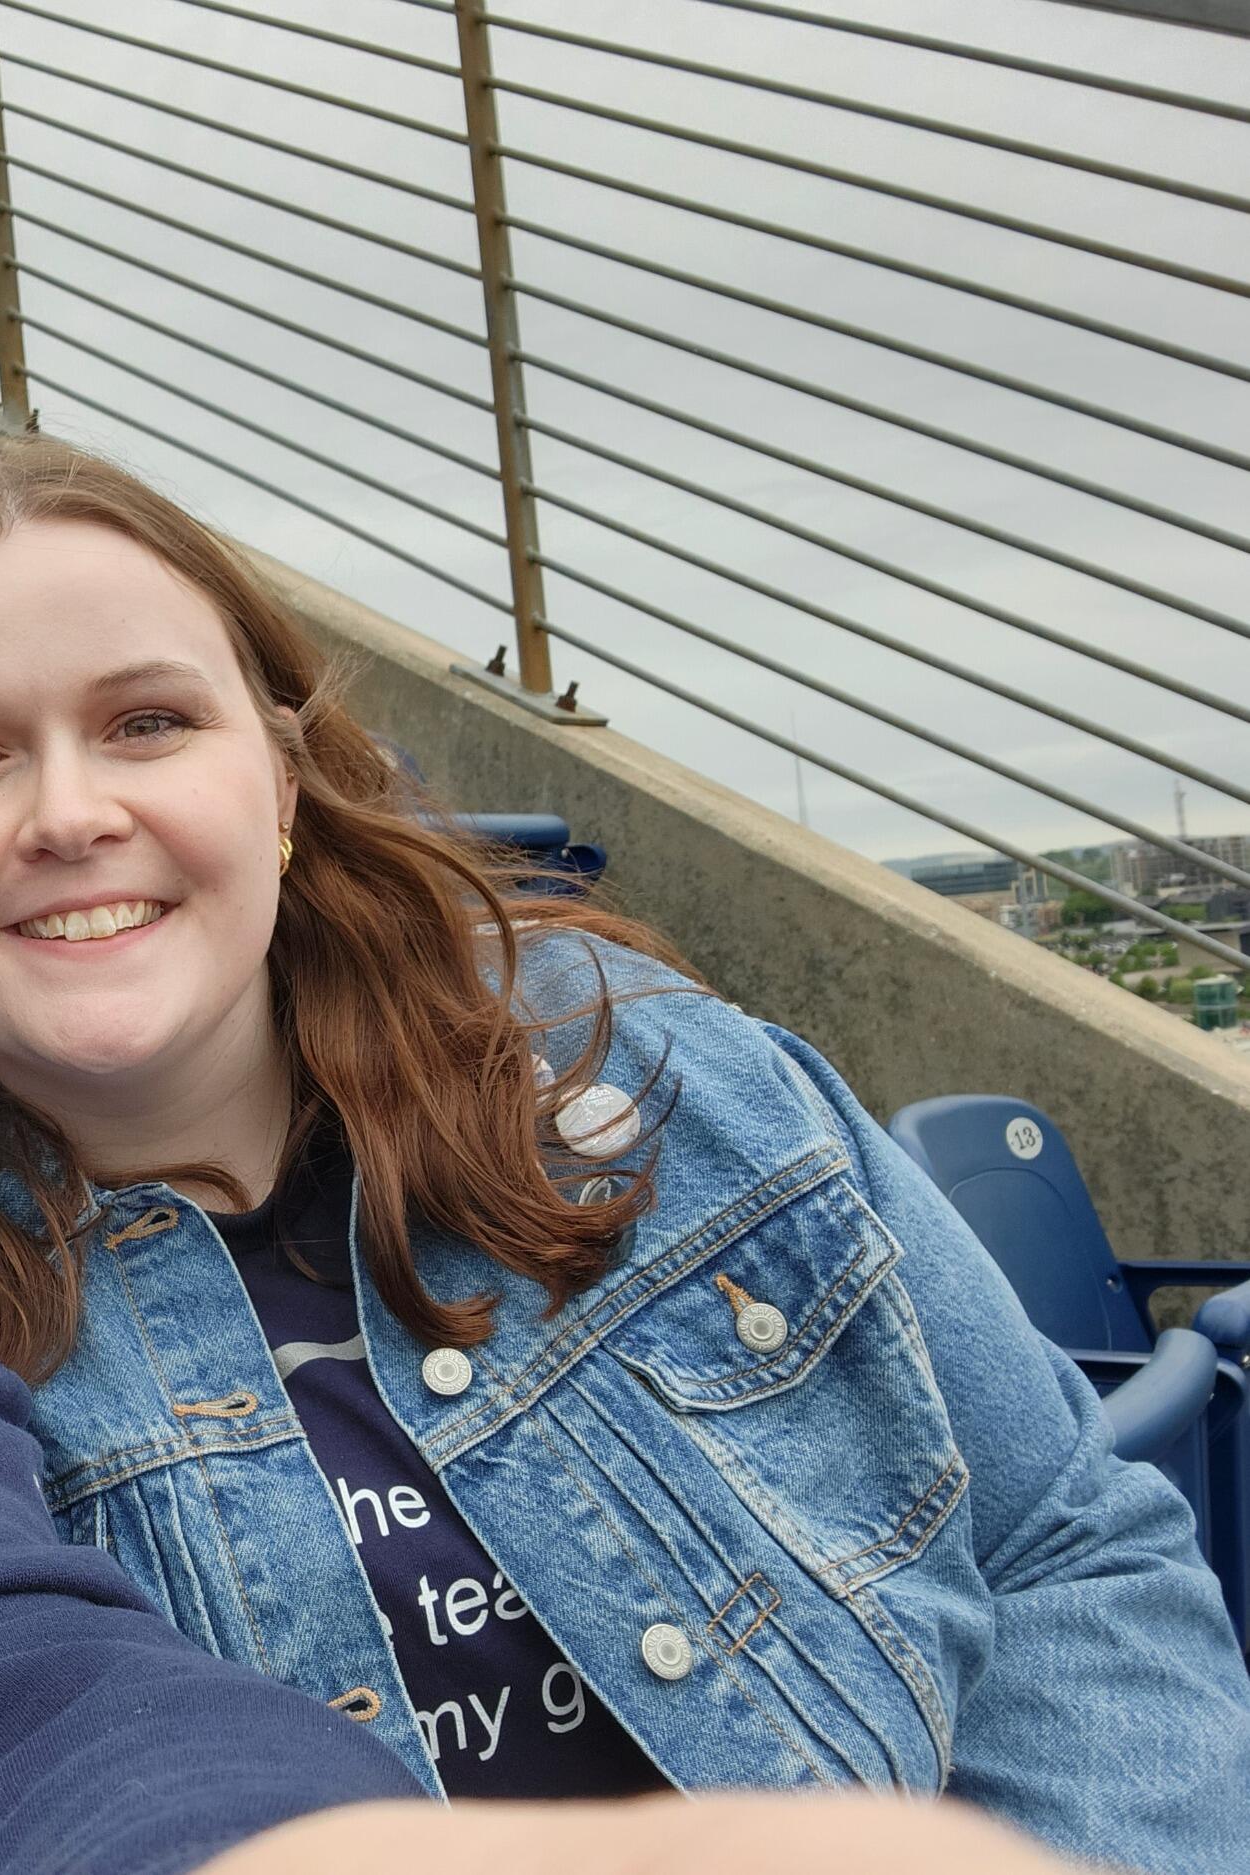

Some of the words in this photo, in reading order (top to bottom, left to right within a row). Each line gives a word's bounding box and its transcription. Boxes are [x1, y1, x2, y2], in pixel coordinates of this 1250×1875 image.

[1014, 1126, 1036, 1150] 13
[337, 1477, 430, 1544] he
[416, 1686, 511, 1761] my
